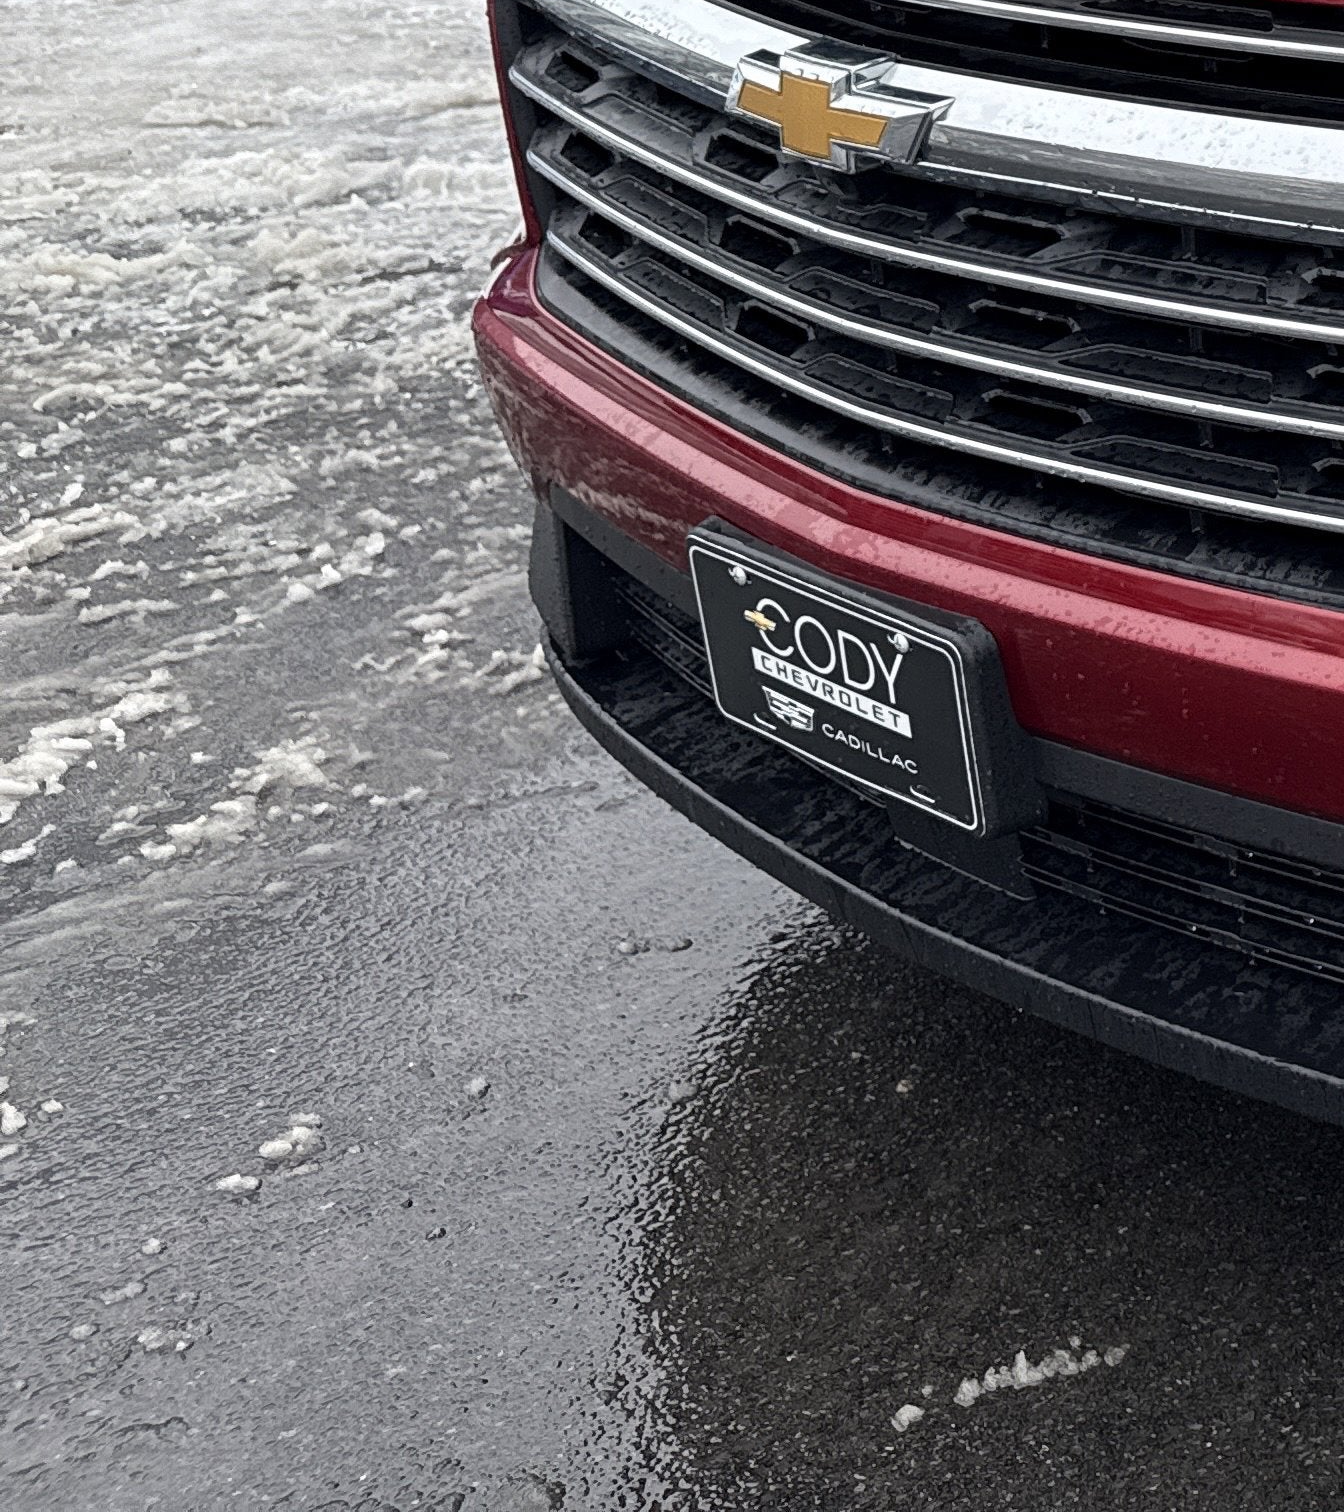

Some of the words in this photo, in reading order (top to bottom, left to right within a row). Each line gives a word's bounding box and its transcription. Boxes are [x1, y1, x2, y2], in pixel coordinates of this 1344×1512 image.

[744, 597, 904, 705] CODY
[759, 652, 903, 731] CHEVROLET
[821, 722, 920, 776] CADILLAC
